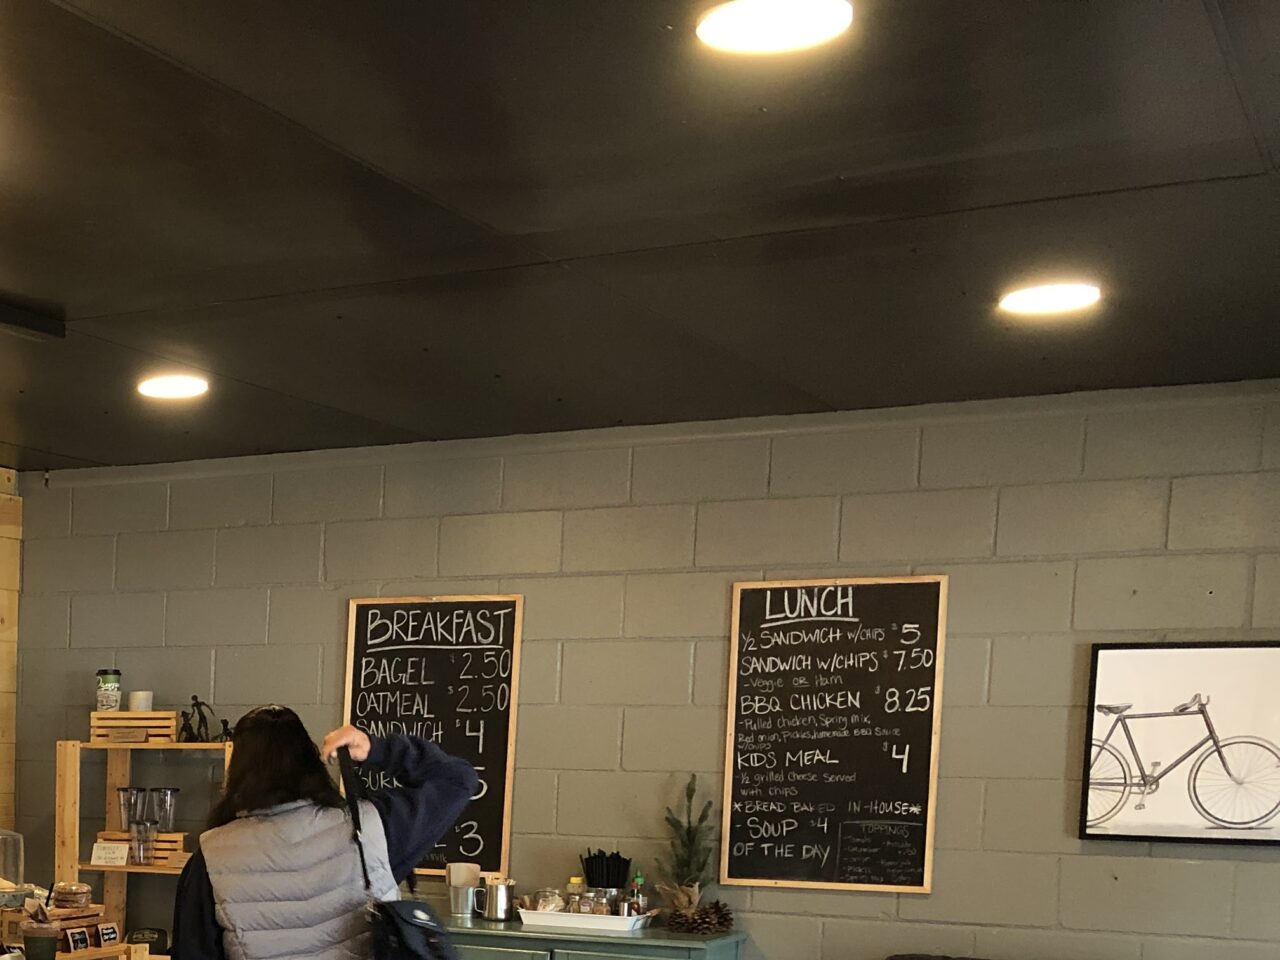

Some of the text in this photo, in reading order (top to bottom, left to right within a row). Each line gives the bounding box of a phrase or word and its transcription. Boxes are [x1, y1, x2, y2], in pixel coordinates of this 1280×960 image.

[765, 586, 854, 619] LUNCH
[366, 608, 512, 646] BREAKFAST
[759, 627, 843, 649] SANDWICH
[360, 657, 435, 689] BAGEL
[739, 655, 812, 676] SANDWICH
[815, 675, 843, 687] Ham
[356, 691, 435, 718] OATMEAL
[740, 695, 783, 715] BBQ
[789, 690, 861, 711] CHICKEN
[737, 751, 777, 770] KIDS
[785, 749, 840, 768] MEAL
[746, 816, 799, 839] SOUP
[732, 842, 756, 857] OF
[760, 842, 795, 859] THE
[800, 843, 831, 869] DAY
